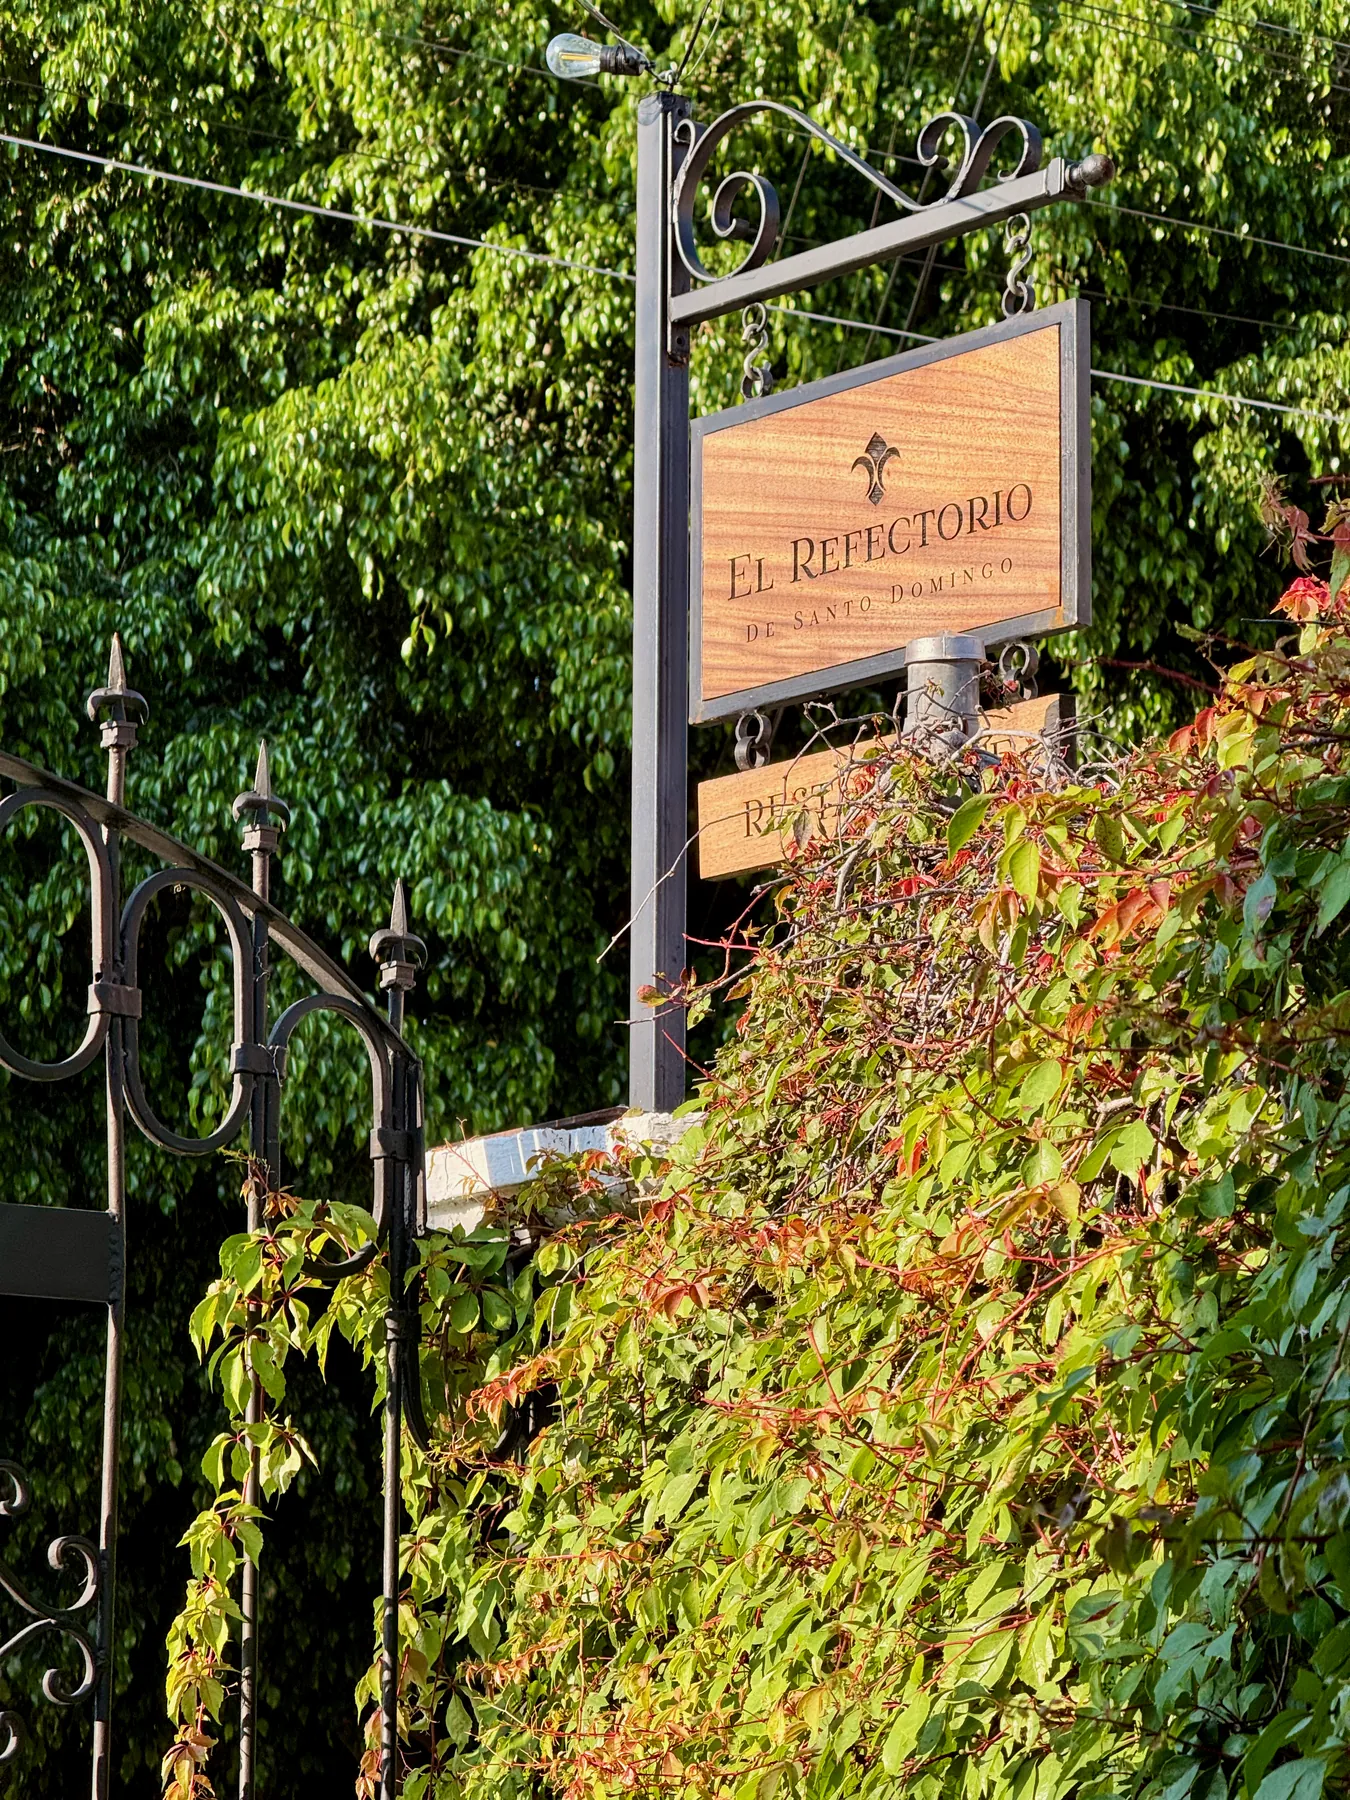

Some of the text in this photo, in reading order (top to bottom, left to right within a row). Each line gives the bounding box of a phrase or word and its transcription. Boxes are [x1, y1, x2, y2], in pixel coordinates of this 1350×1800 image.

[728, 483, 1033, 601] EL REFECTORIO
[747, 557, 1013, 643] DE SANTO DOMINGO
